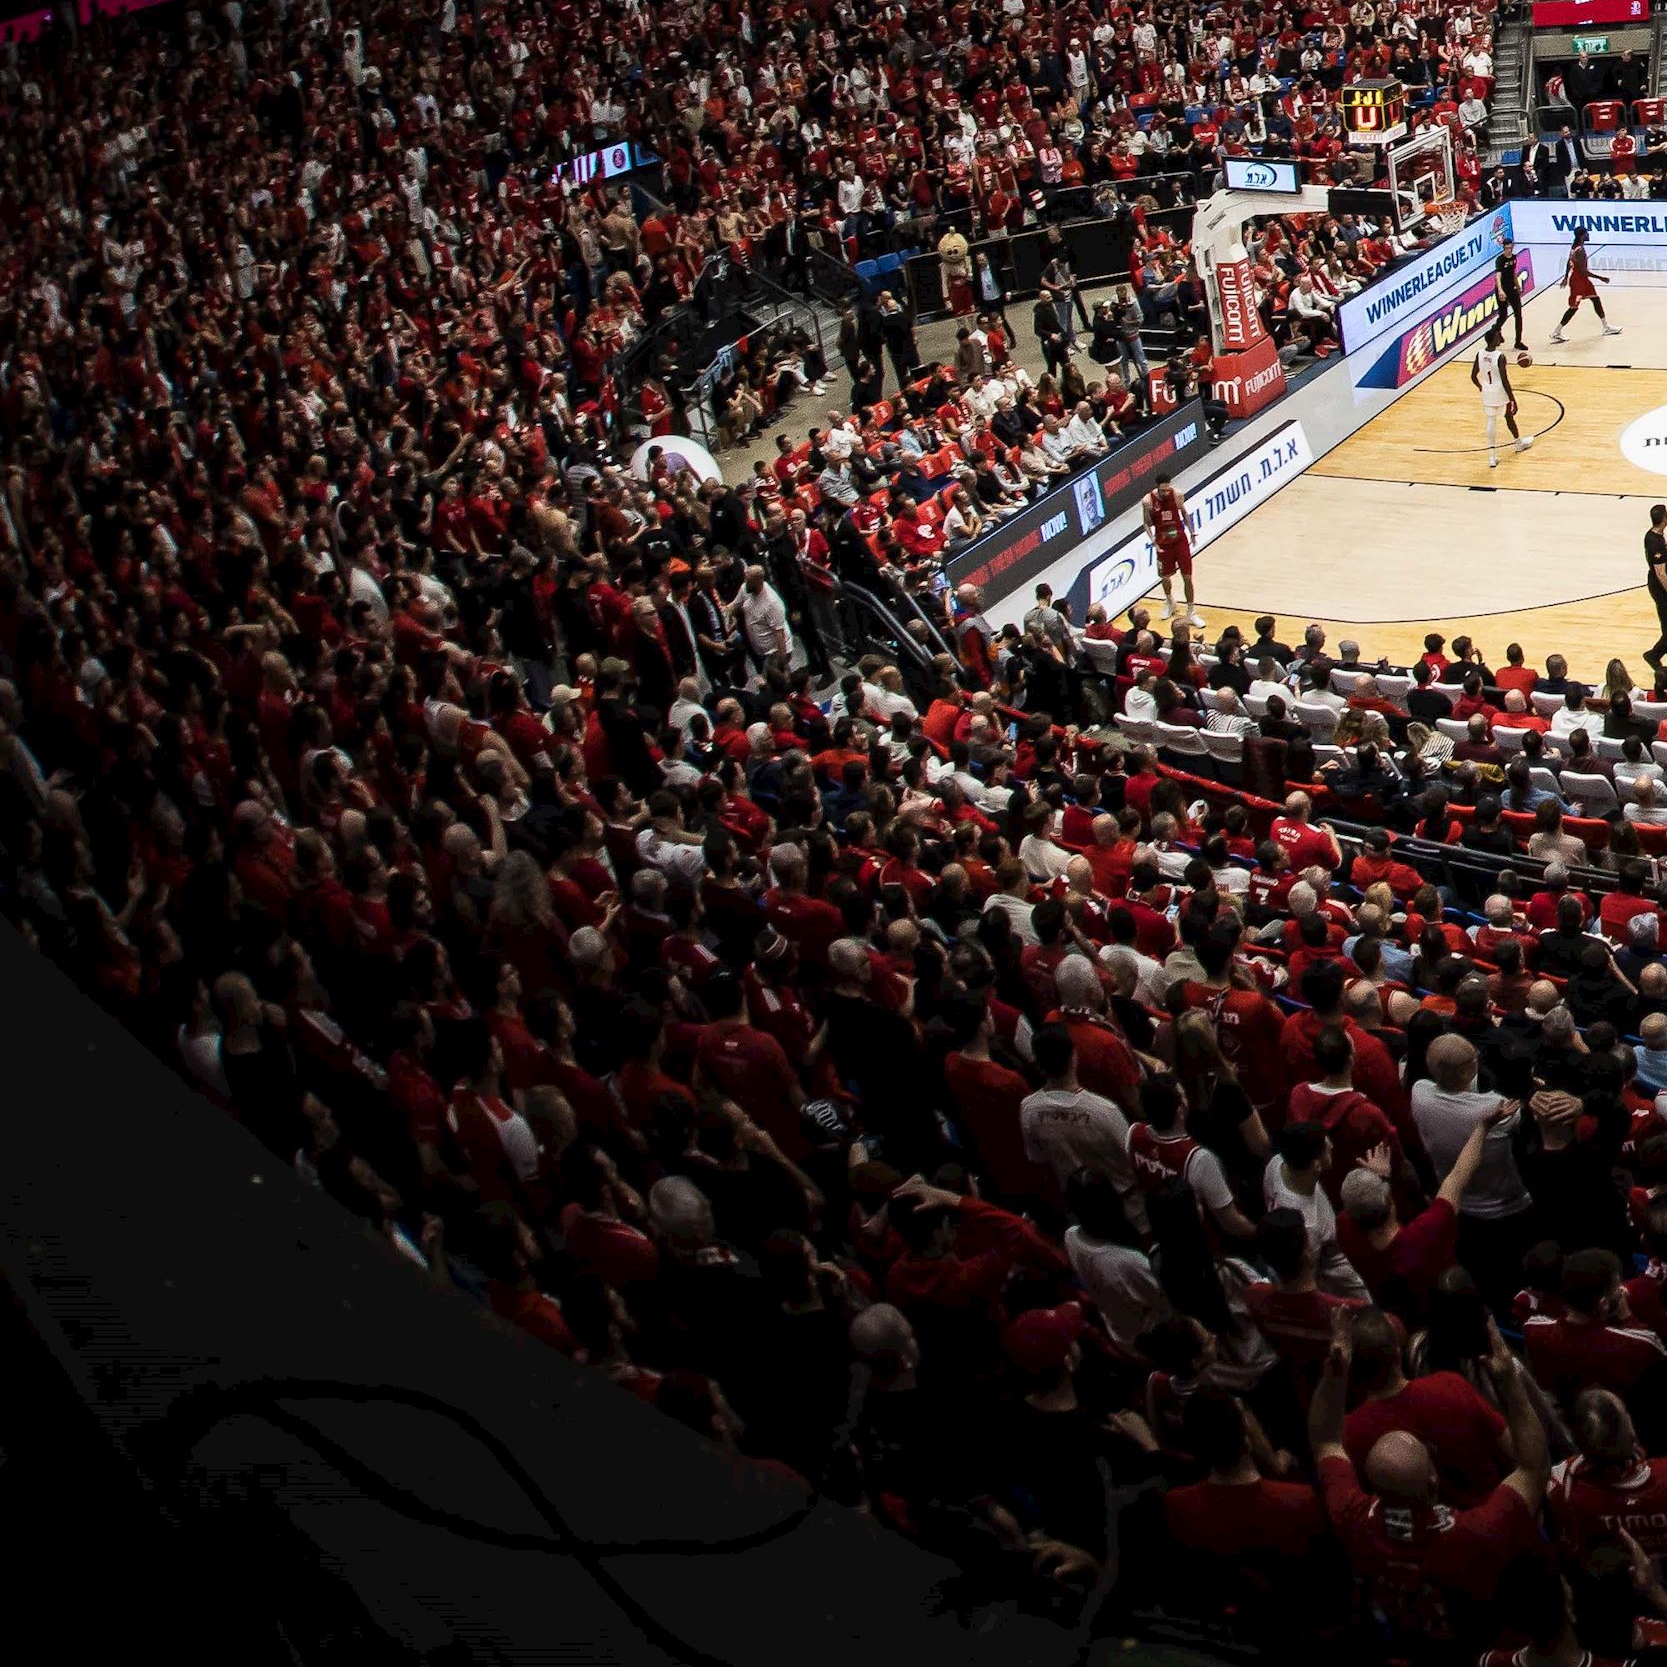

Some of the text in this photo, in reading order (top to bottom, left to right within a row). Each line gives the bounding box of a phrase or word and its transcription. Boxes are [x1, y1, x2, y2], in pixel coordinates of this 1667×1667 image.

[1366, 234, 1483, 324] WINNERLEAGUE.TV
[1486, 370, 1493, 385] 1
[1205, 470, 1253, 521] חשמל
[1040, 510, 1069, 542] NOW!
